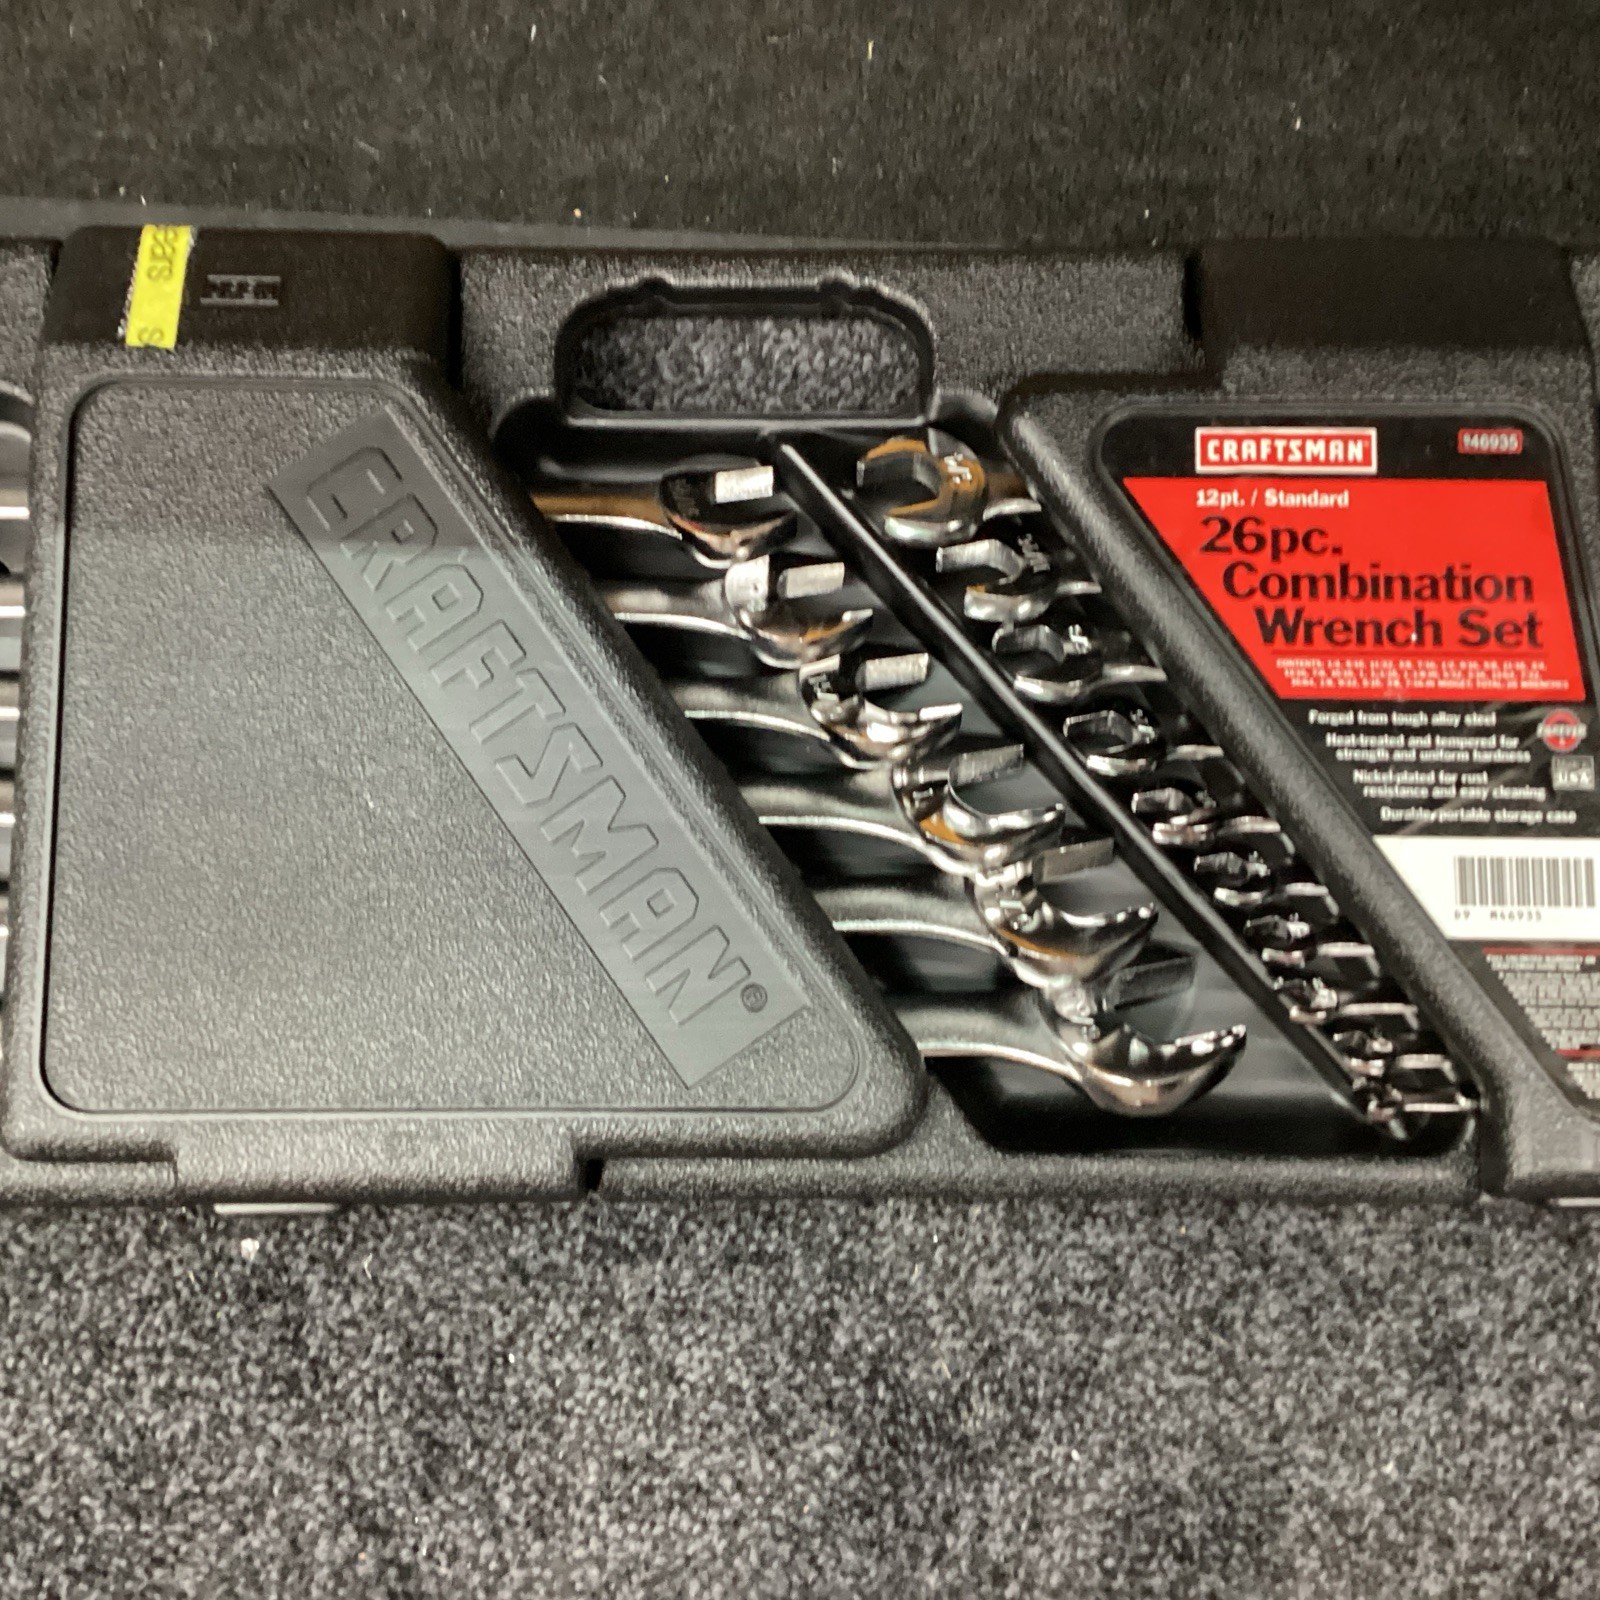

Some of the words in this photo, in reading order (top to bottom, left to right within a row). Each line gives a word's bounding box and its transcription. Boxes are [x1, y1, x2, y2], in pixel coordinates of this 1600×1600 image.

[1206, 438, 1367, 464] CRAFTSMAN
[1196, 488, 1246, 509] 12pt.
[1250, 489, 1258, 506] /
[1264, 488, 1349, 508] Standard
[1200, 516, 1342, 562] 26pc.
[1222, 562, 1533, 601] Combination
[1254, 607, 1443, 647] Wrench
[1458, 608, 1540, 647] Set
[1309, 709, 1354, 726] Forged
[1357, 710, 1388, 725] from
[1391, 711, 1428, 727] tough
[1431, 711, 1461, 728] alloy
[1464, 711, 1496, 727] steel
[1407, 734, 1432, 748] and
[1435, 734, 1497, 751] tempered
[1499, 734, 1519, 750] for
[1335, 748, 1390, 764] strength
[1392, 749, 1416, 762] and
[1419, 749, 1470, 763] uniform
[1472, 749, 1532, 764] hardness
[1438, 770, 1458, 784] for
[1460, 770, 1489, 784] rust
[1363, 784, 1429, 799] resistance
[1431, 785, 1456, 799] and
[1459, 786, 1489, 802] easy
[1492, 786, 1547, 803] cleaning
[1494, 808, 1543, 825] storage
[1546, 810, 1578, 824] case
